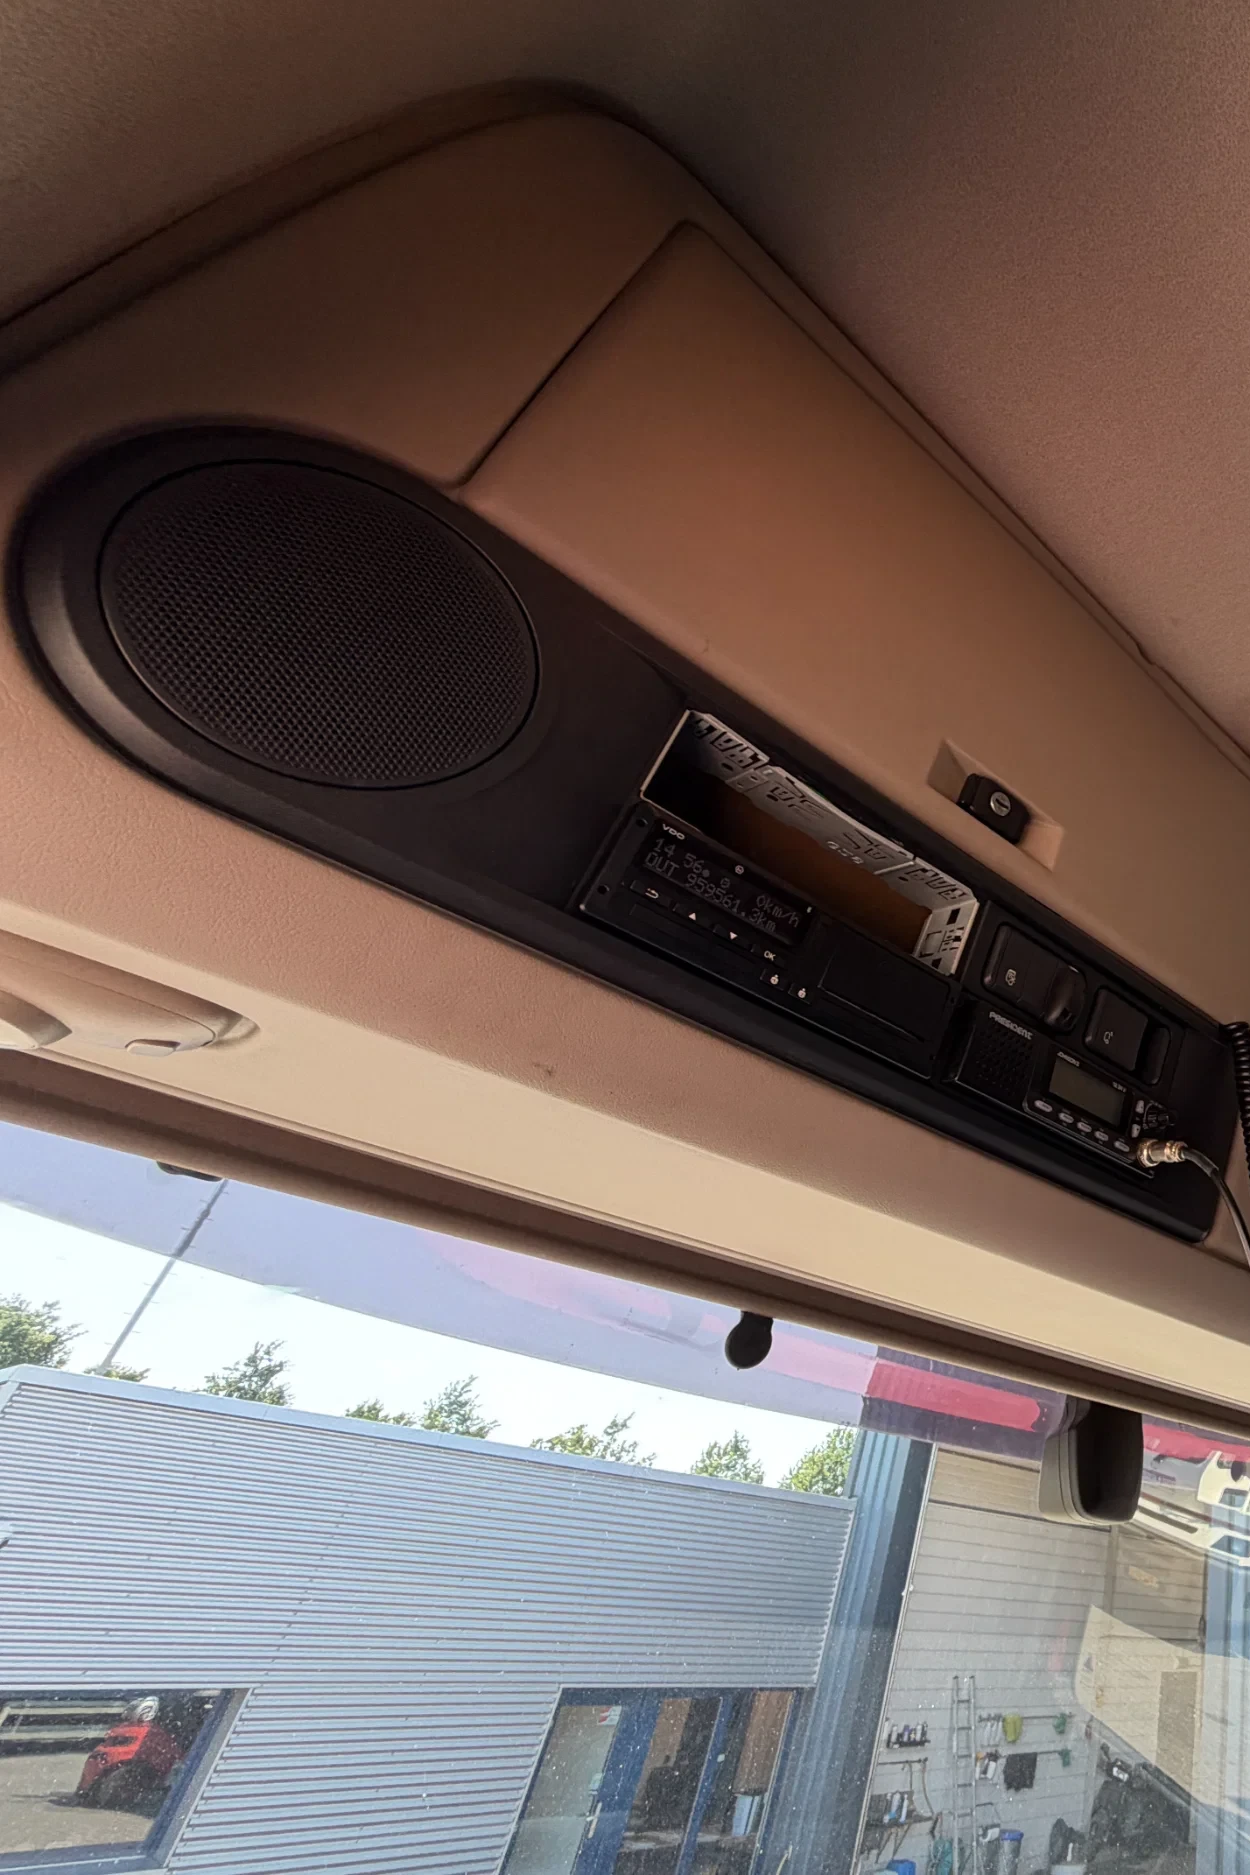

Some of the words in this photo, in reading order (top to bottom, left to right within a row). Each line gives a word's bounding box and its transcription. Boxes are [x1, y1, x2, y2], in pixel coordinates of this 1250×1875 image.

[662, 823, 686, 840] VDO
[645, 852, 680, 877] OUT
[763, 950, 776, 961] OK
[989, 1011, 1033, 1040] PRESIDENT
